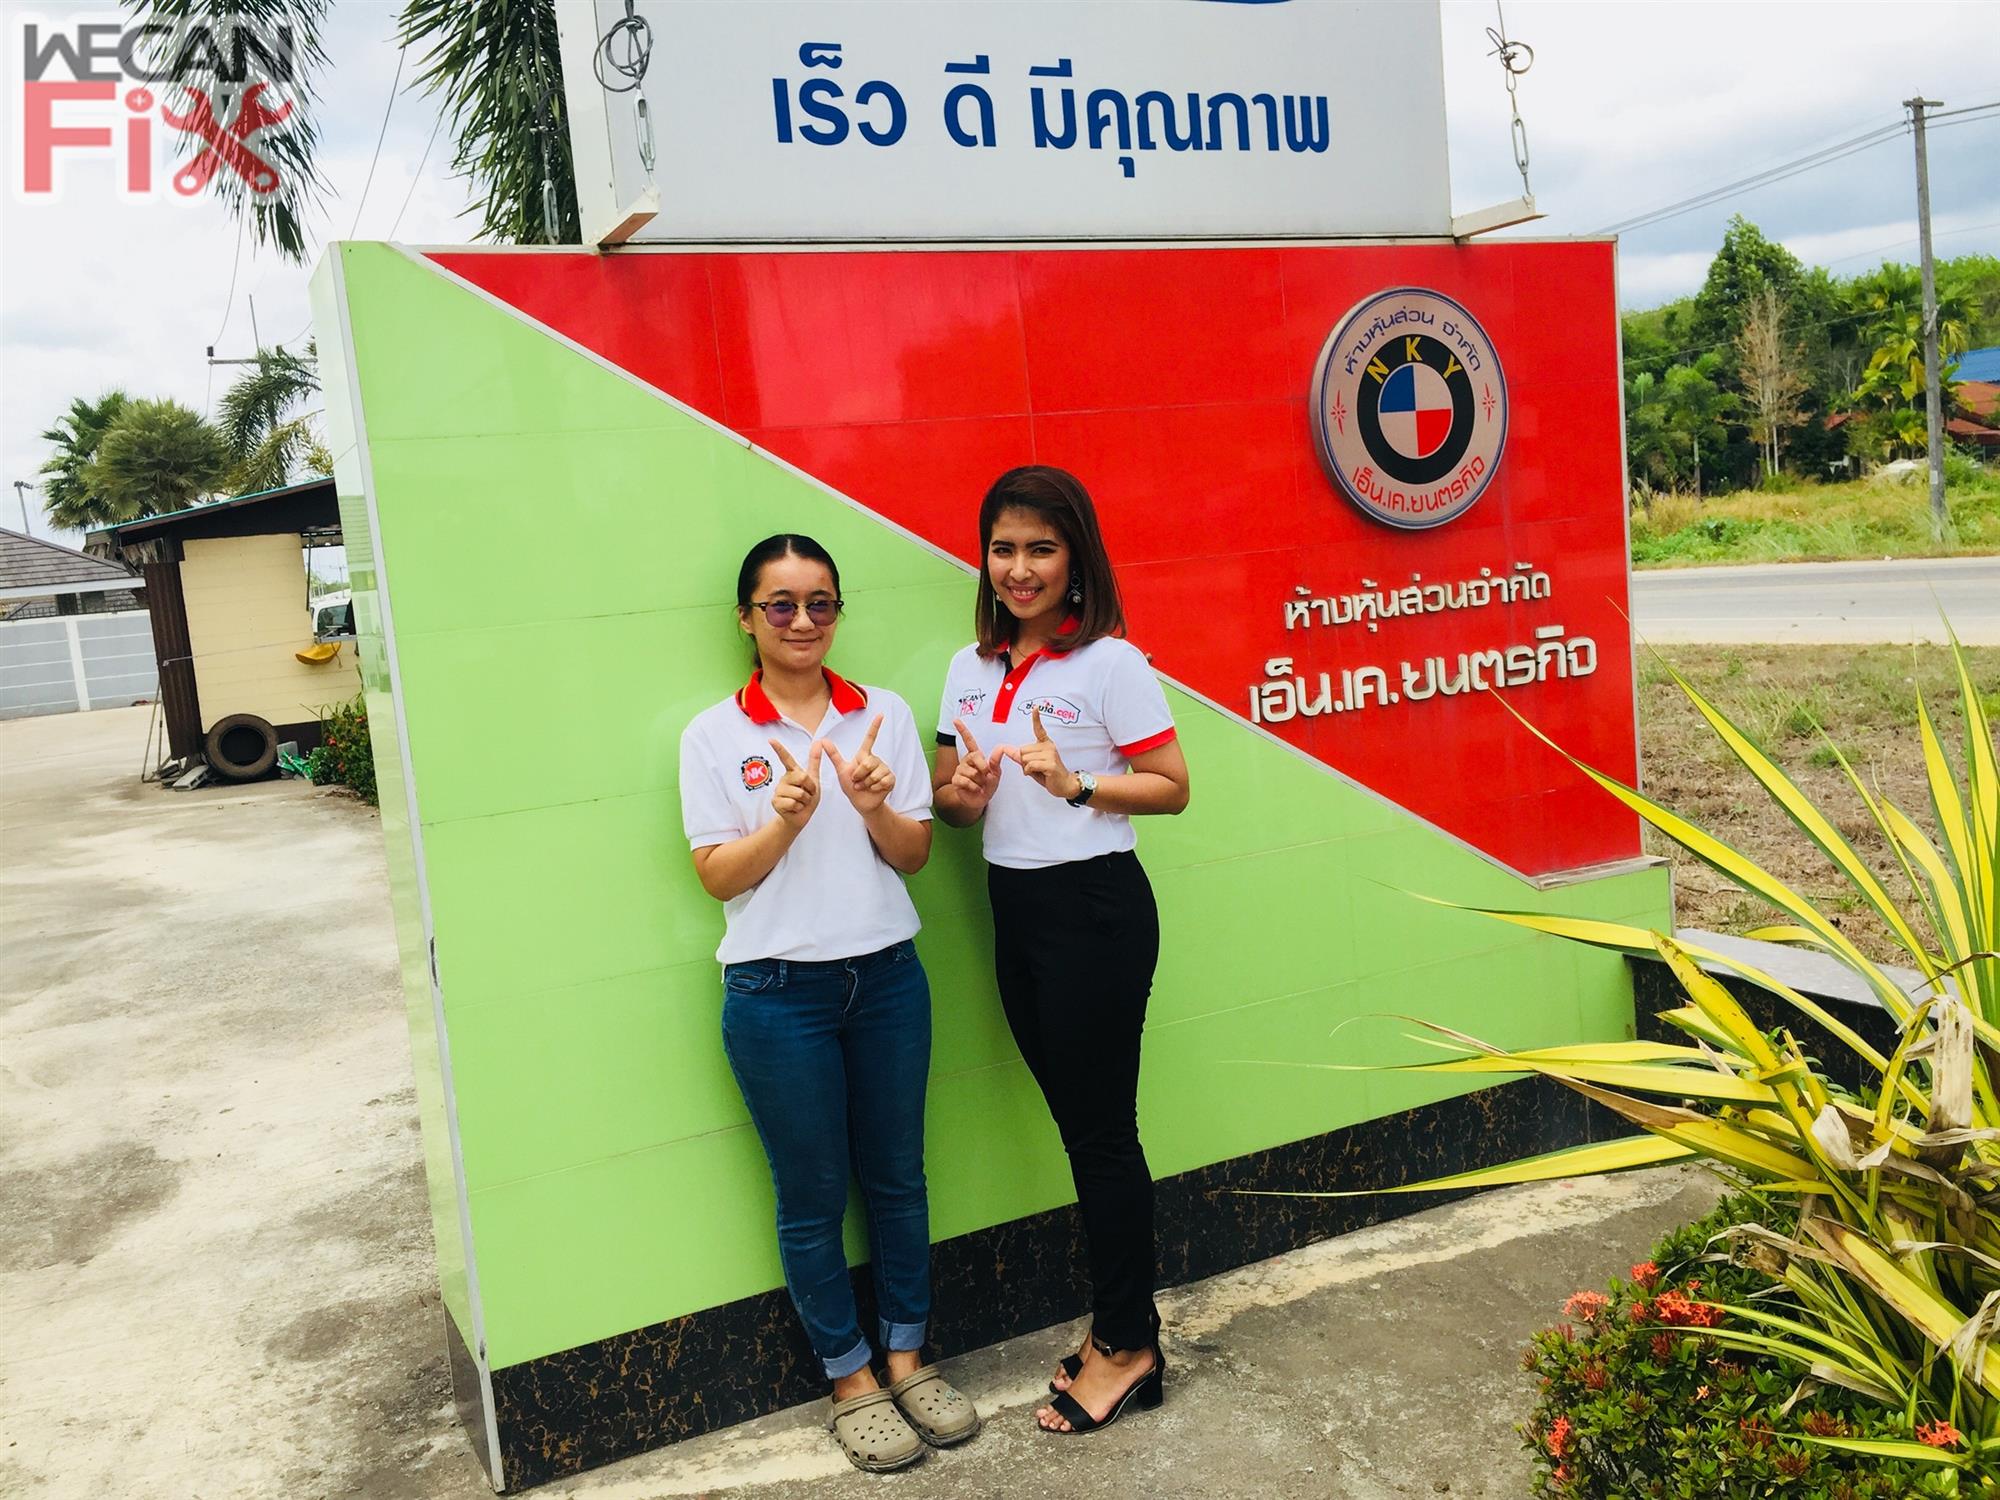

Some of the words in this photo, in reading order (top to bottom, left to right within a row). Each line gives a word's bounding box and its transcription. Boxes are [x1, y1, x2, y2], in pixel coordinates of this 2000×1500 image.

[773, 42, 907, 147] เร็ว
[943, 54, 997, 148] ดี
[1029, 58, 1331, 178] มีคุณภาพ
[1344, 306, 1435, 376] ห้างหุ้นส่วน
[1442, 321, 1482, 372] จำกัด
[1366, 336, 1463, 384] NKY
[1352, 455, 1486, 514] เอ็น.เค.ยนตรกิจ
[1284, 561, 1552, 633] ห้างหุ้นส่วนจำกัด
[1249, 624, 1599, 725] เอ็น.เค.ยนตรกิจ
[746, 765, 766, 781] NK
